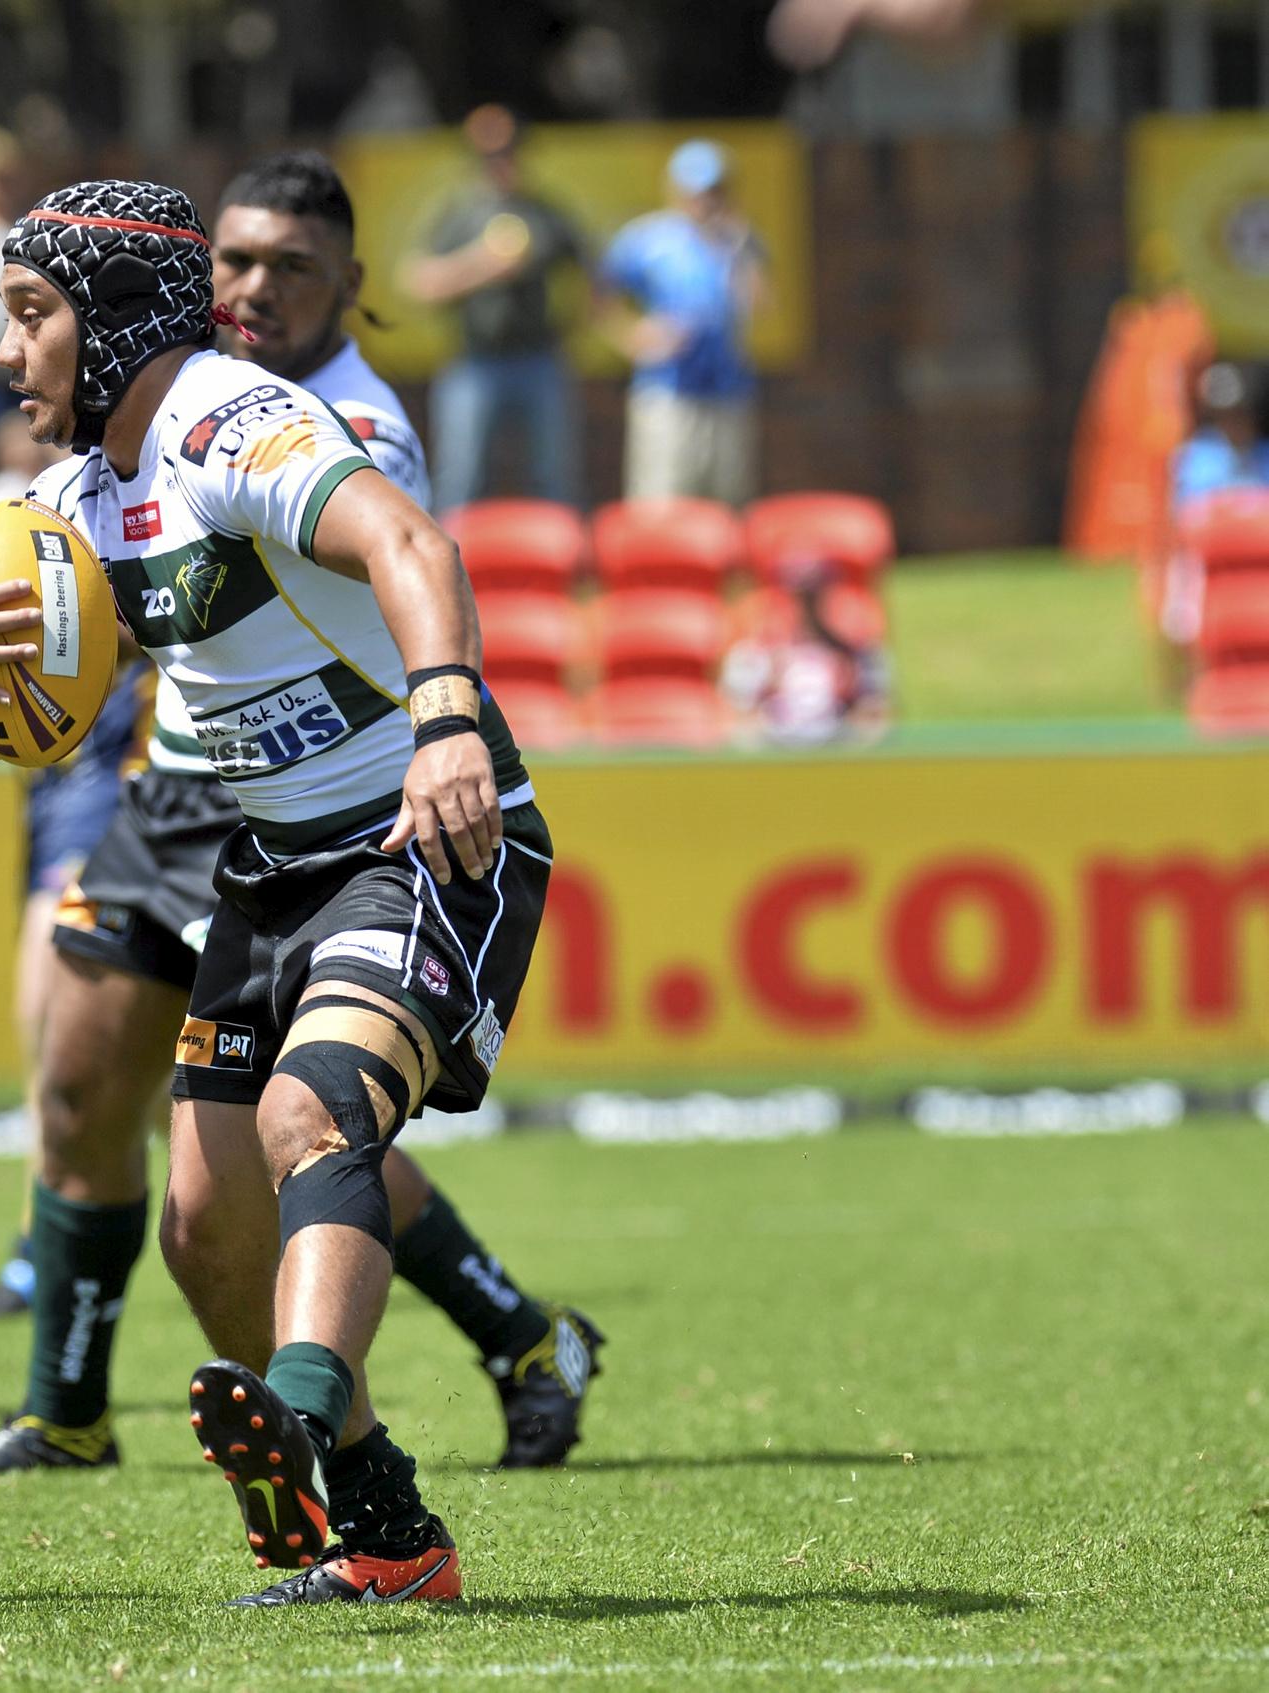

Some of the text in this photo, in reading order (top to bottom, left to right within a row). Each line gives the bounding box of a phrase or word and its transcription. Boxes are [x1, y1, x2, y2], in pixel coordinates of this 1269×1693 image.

[214, 386, 277, 418] nab
[39, 531, 65, 560] CAT
[55, 570, 69, 657] Hastings Deering
[141, 586, 176, 619] 20
[239, 705, 275, 730] Ask
[278, 692, 323, 712] Us...
[428, 961, 446, 979] QLD
[218, 1033, 251, 1058] CAT
